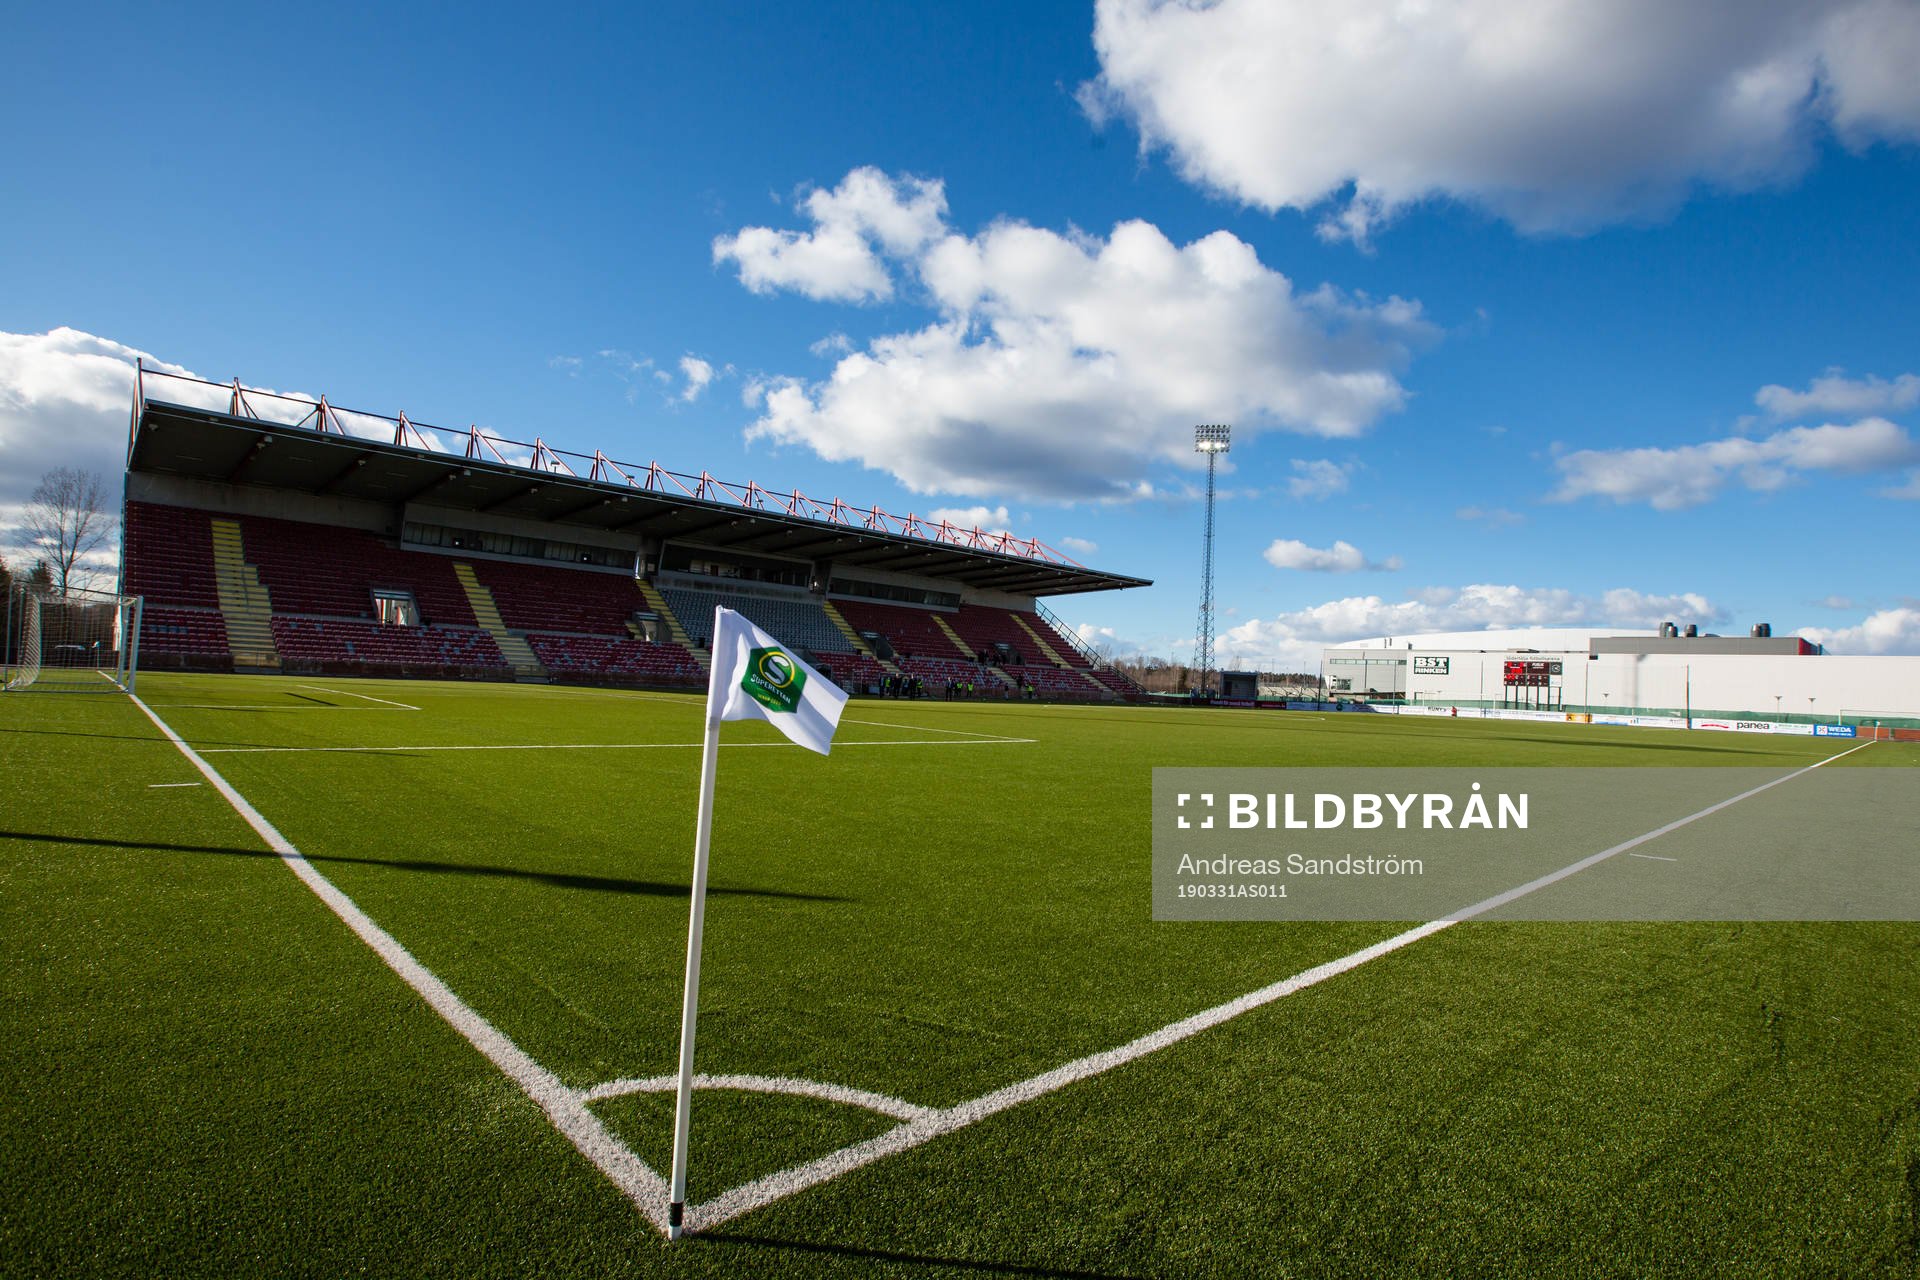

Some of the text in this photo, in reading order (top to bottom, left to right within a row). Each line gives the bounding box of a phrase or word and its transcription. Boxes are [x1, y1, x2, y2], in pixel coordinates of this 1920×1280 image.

[1415, 657, 1447, 668] BST
[750, 673, 791, 704] SUPERETTAN
[1736, 721, 1770, 730] panea
